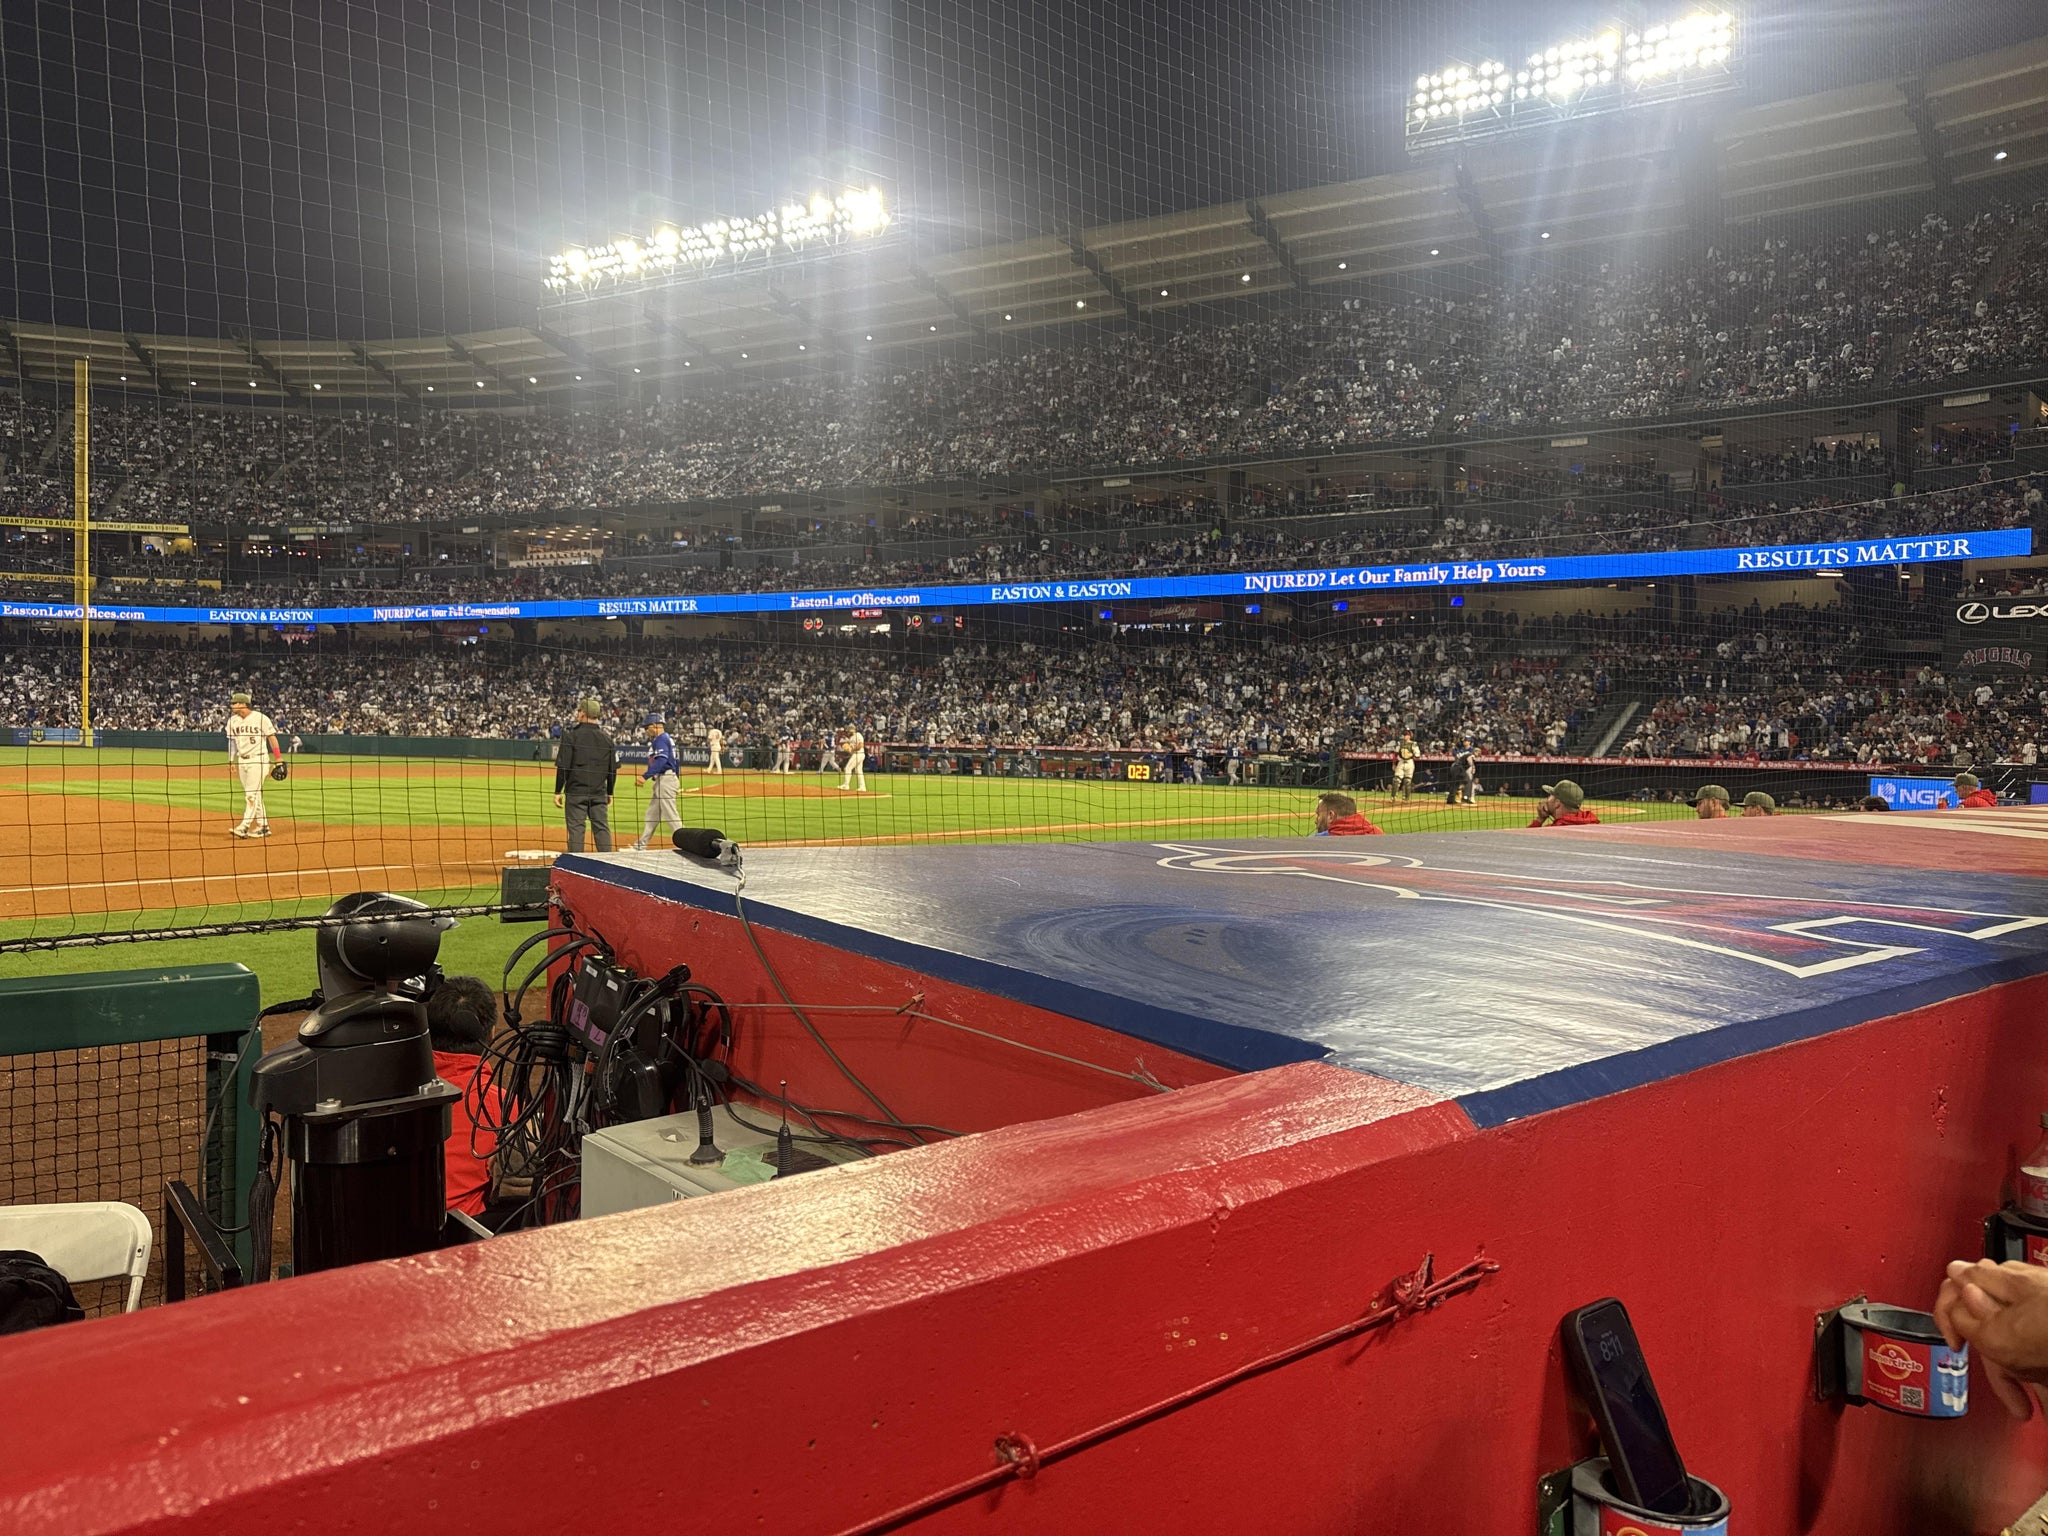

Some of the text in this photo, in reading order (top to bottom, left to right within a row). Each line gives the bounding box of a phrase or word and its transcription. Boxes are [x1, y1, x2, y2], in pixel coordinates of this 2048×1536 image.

[1737, 538, 1973, 569] RESULTS MATTER
[1244, 563, 1546, 592] INJURED? Let Our Family Help Yours
[991, 582, 1132, 600] EASTON & EASTON
[598, 599, 698, 613] RESULTS MATTER
[790, 593, 921, 608] EastonLawOffices.com
[209, 610, 314, 621] EASTON & EASTON
[373, 608, 414, 620] INJURED?
[415, 607, 429, 618] Get
[464, 605, 520, 617] Compensation
[1960, 646, 2032, 669] ANGELS
[249, 736, 256, 745] 5
[683, 751, 710, 761] Modelo
[1127, 764, 1150, 780] 023
[1900, 788, 1951, 805] NGK
[1600, 1334, 1625, 1362] 8:11
